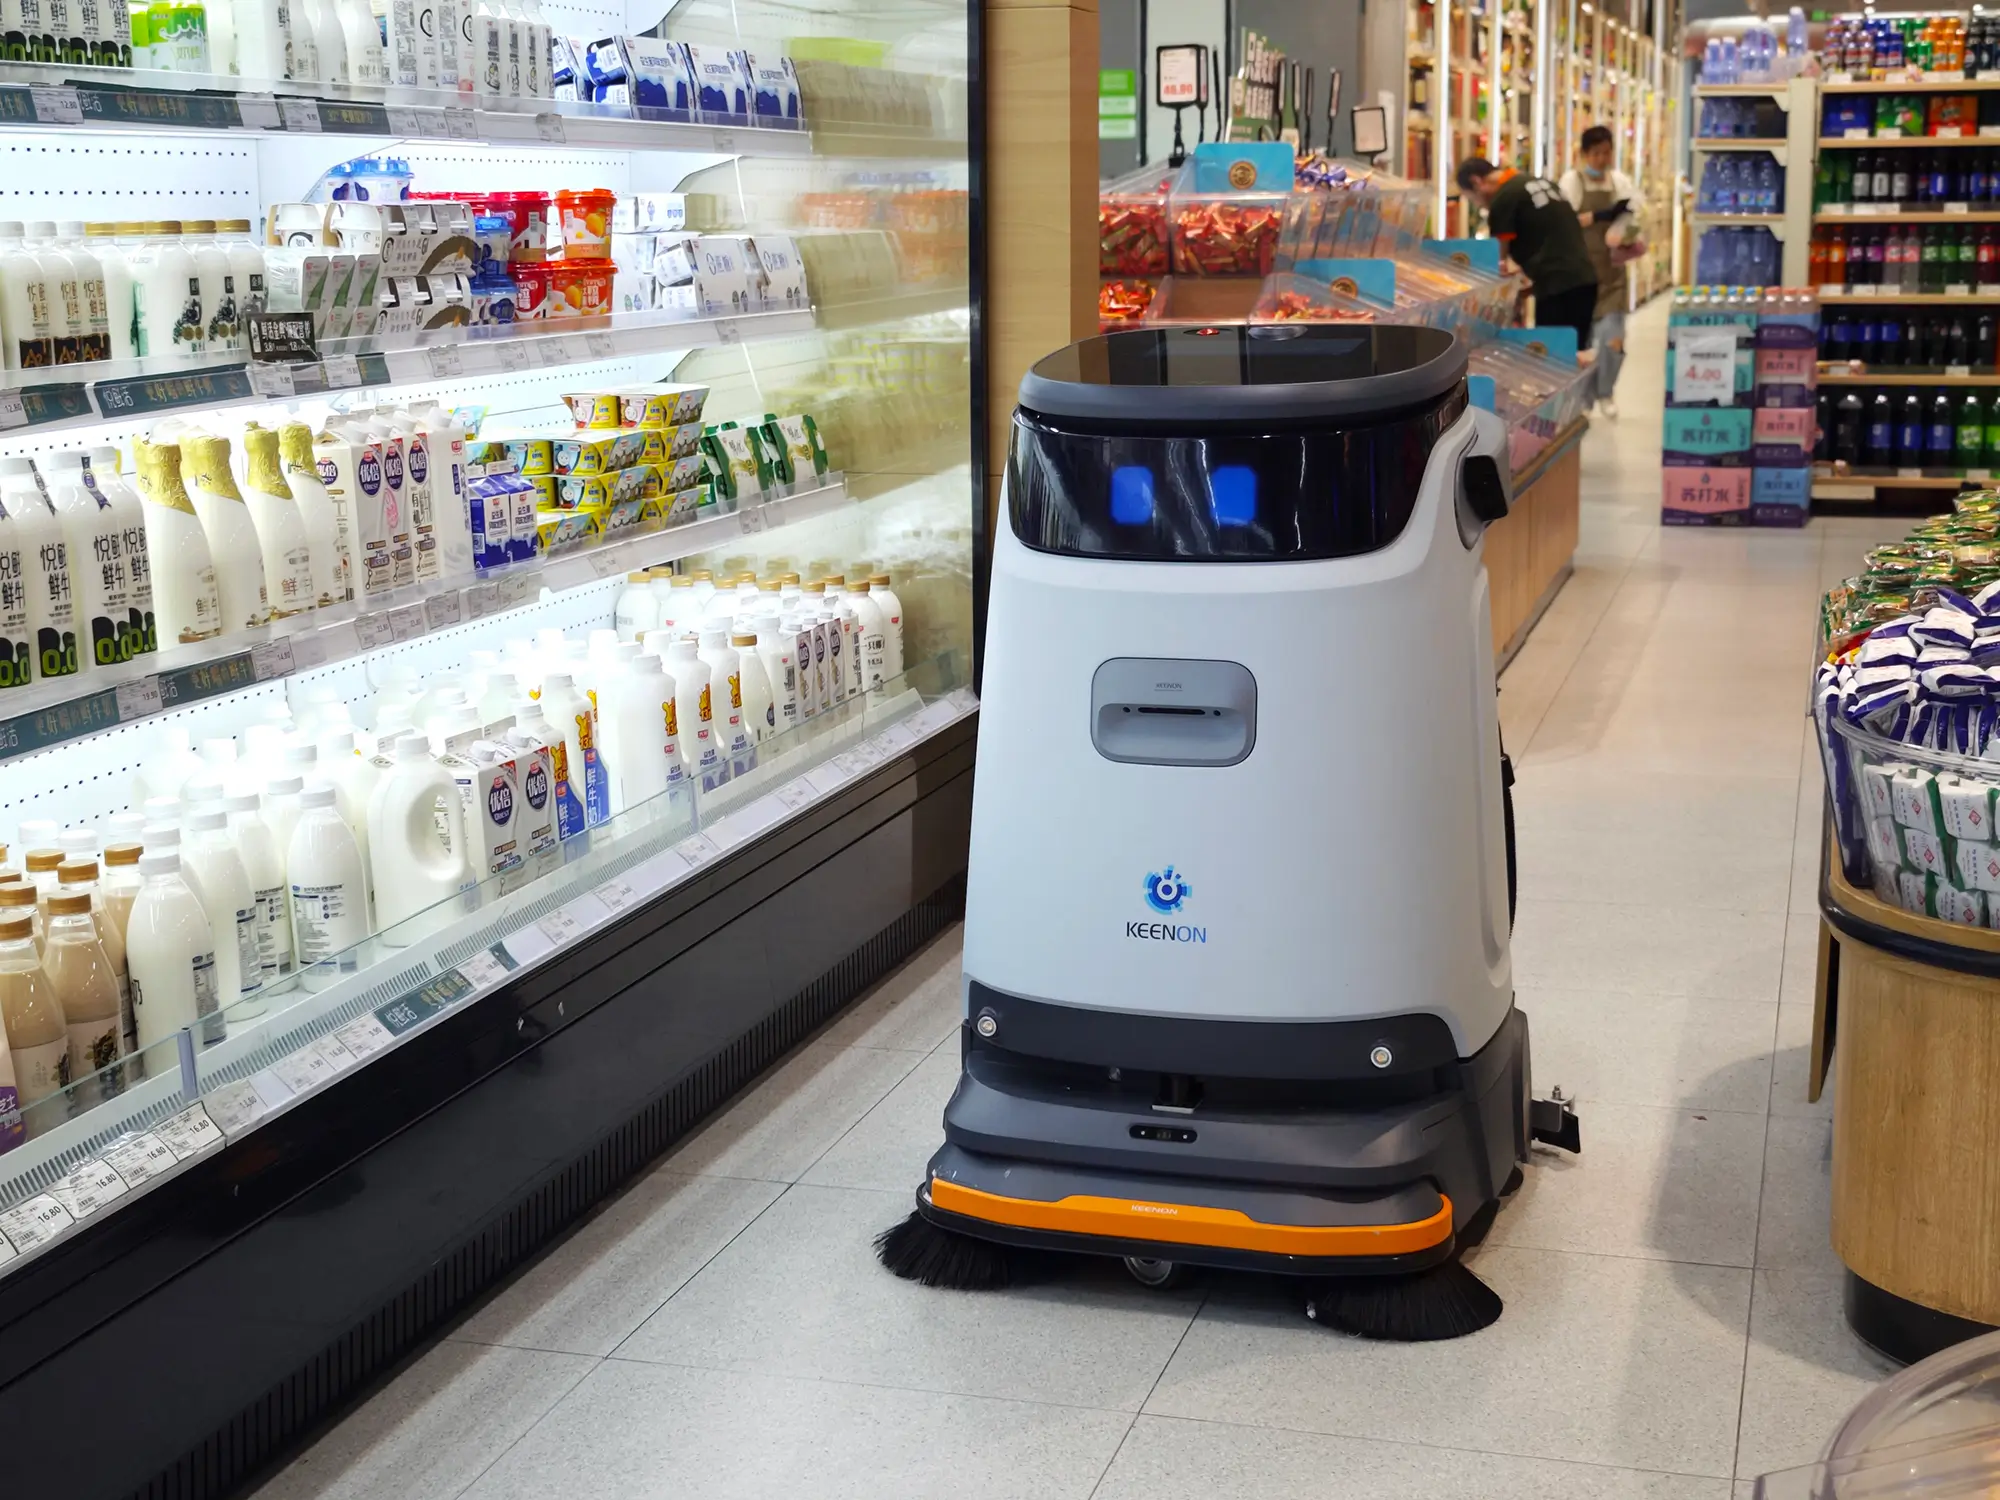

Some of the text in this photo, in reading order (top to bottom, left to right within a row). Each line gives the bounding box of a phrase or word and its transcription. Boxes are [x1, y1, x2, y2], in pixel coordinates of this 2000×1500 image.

[1682, 429, 1730, 444] 苏打水
[385, 458, 402, 478] 优倍
[409, 451, 426, 471] 优倍
[360, 463, 379, 484] 优倍
[1681, 488, 1729, 503] 苏打水
[526, 774, 547, 796] 优倍
[490, 788, 512, 812] 优倍
[1126, 921, 1206, 943] KEENON
[189, 1119, 209, 1135] 16.80
[147, 1146, 166, 1161] 16.80
[95, 1173, 117, 1190] 16.80
[38, 1205, 62, 1224] 16.80
[1131, 1204, 1178, 1215] KEENON
